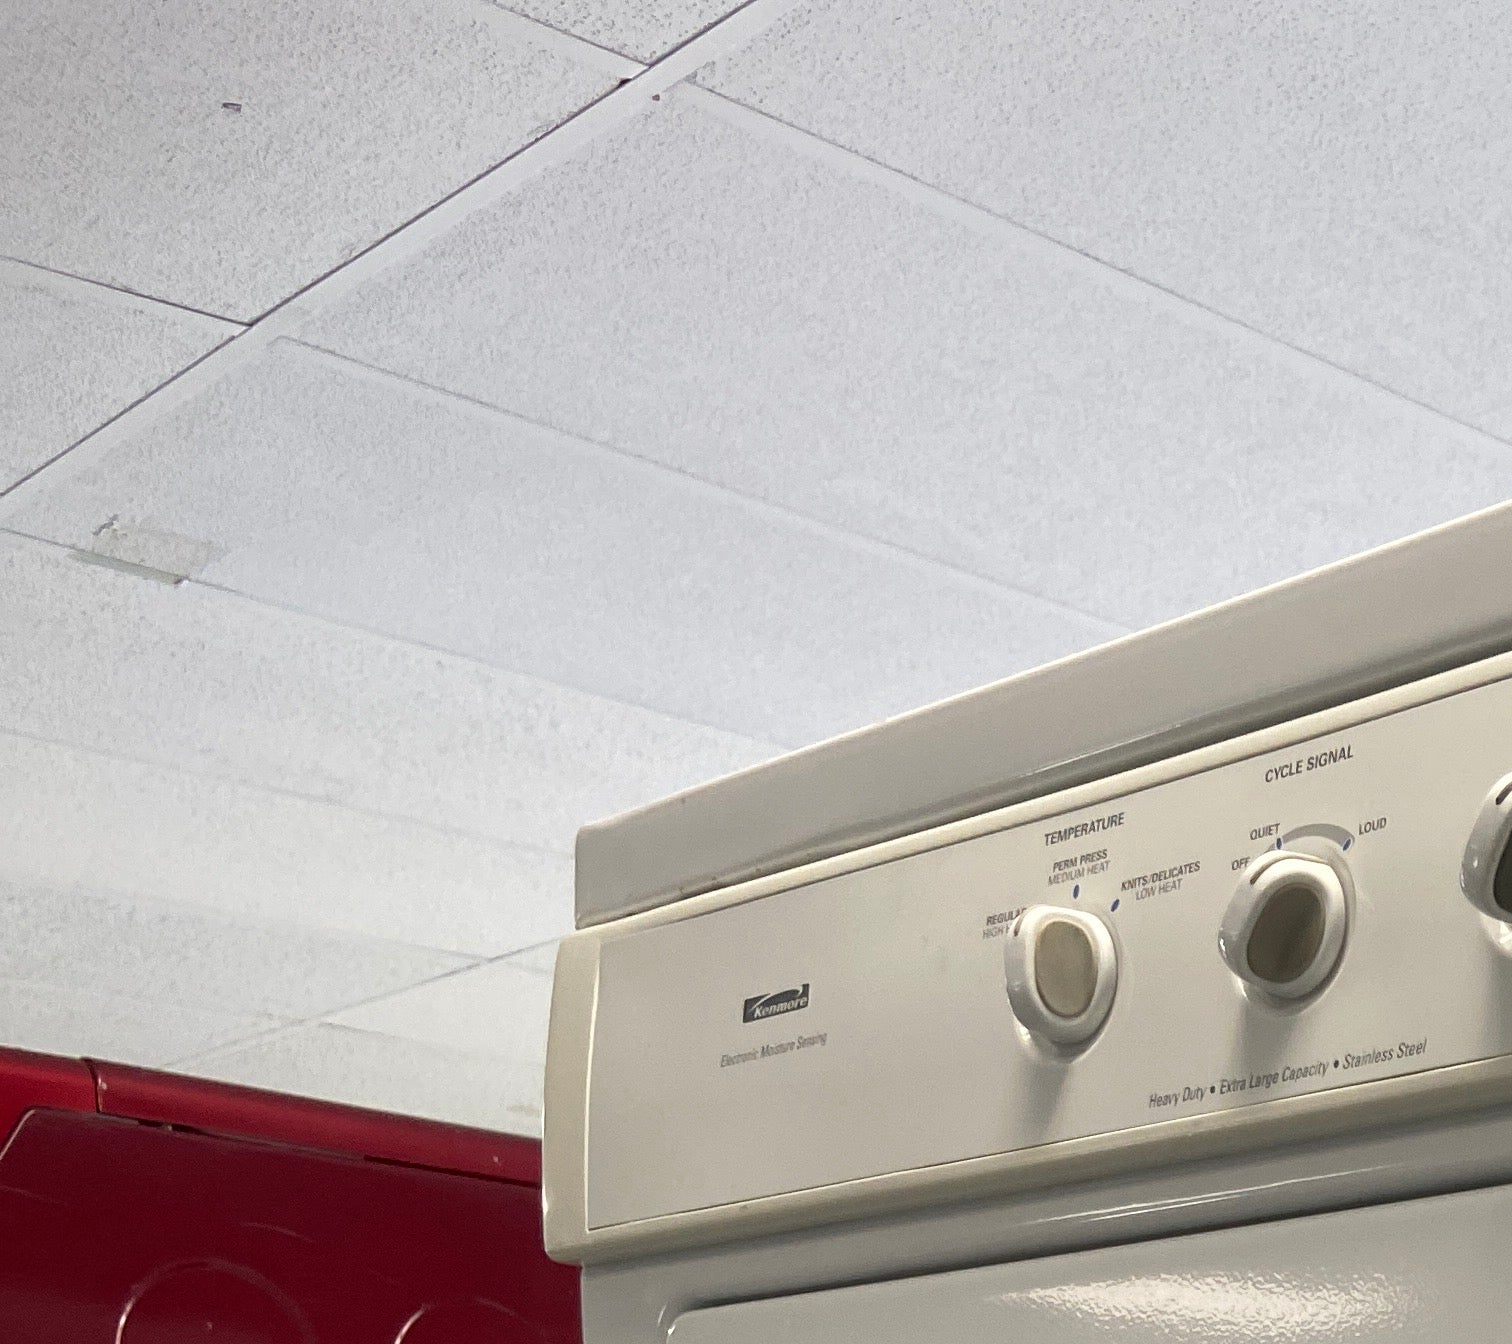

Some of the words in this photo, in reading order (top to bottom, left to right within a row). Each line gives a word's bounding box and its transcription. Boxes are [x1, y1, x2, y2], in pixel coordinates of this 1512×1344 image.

[1265, 760, 1303, 783] CYCLE
[1307, 745, 1353, 772] SIGNAL
[1044, 812, 1125, 846] TEMPERATURE
[1250, 823, 1280, 841] QUIET
[1358, 818, 1387, 836] LOUD
[1048, 868, 1085, 886] MEDIUM
[1087, 860, 1111, 875] HEAT
[1053, 857, 1077, 873] PERM
[1080, 849, 1108, 865] PRESS
[1231, 856, 1250, 871] OFF
[1121, 860, 1200, 891] KNITS/DELICATES
[1136, 884, 1157, 901] LOW
[1158, 878, 1183, 897] HEAT
[1148, 1092, 1181, 1110] Heavy
[1183, 1085, 1208, 1103] Duty
[1219, 1078, 1246, 1096] Extra
[1249, 1071, 1280, 1090] Large
[1282, 1061, 1330, 1083] Capacity
[1342, 1047, 1395, 1070] Stainless
[1396, 1038, 1428, 1059] Steel
